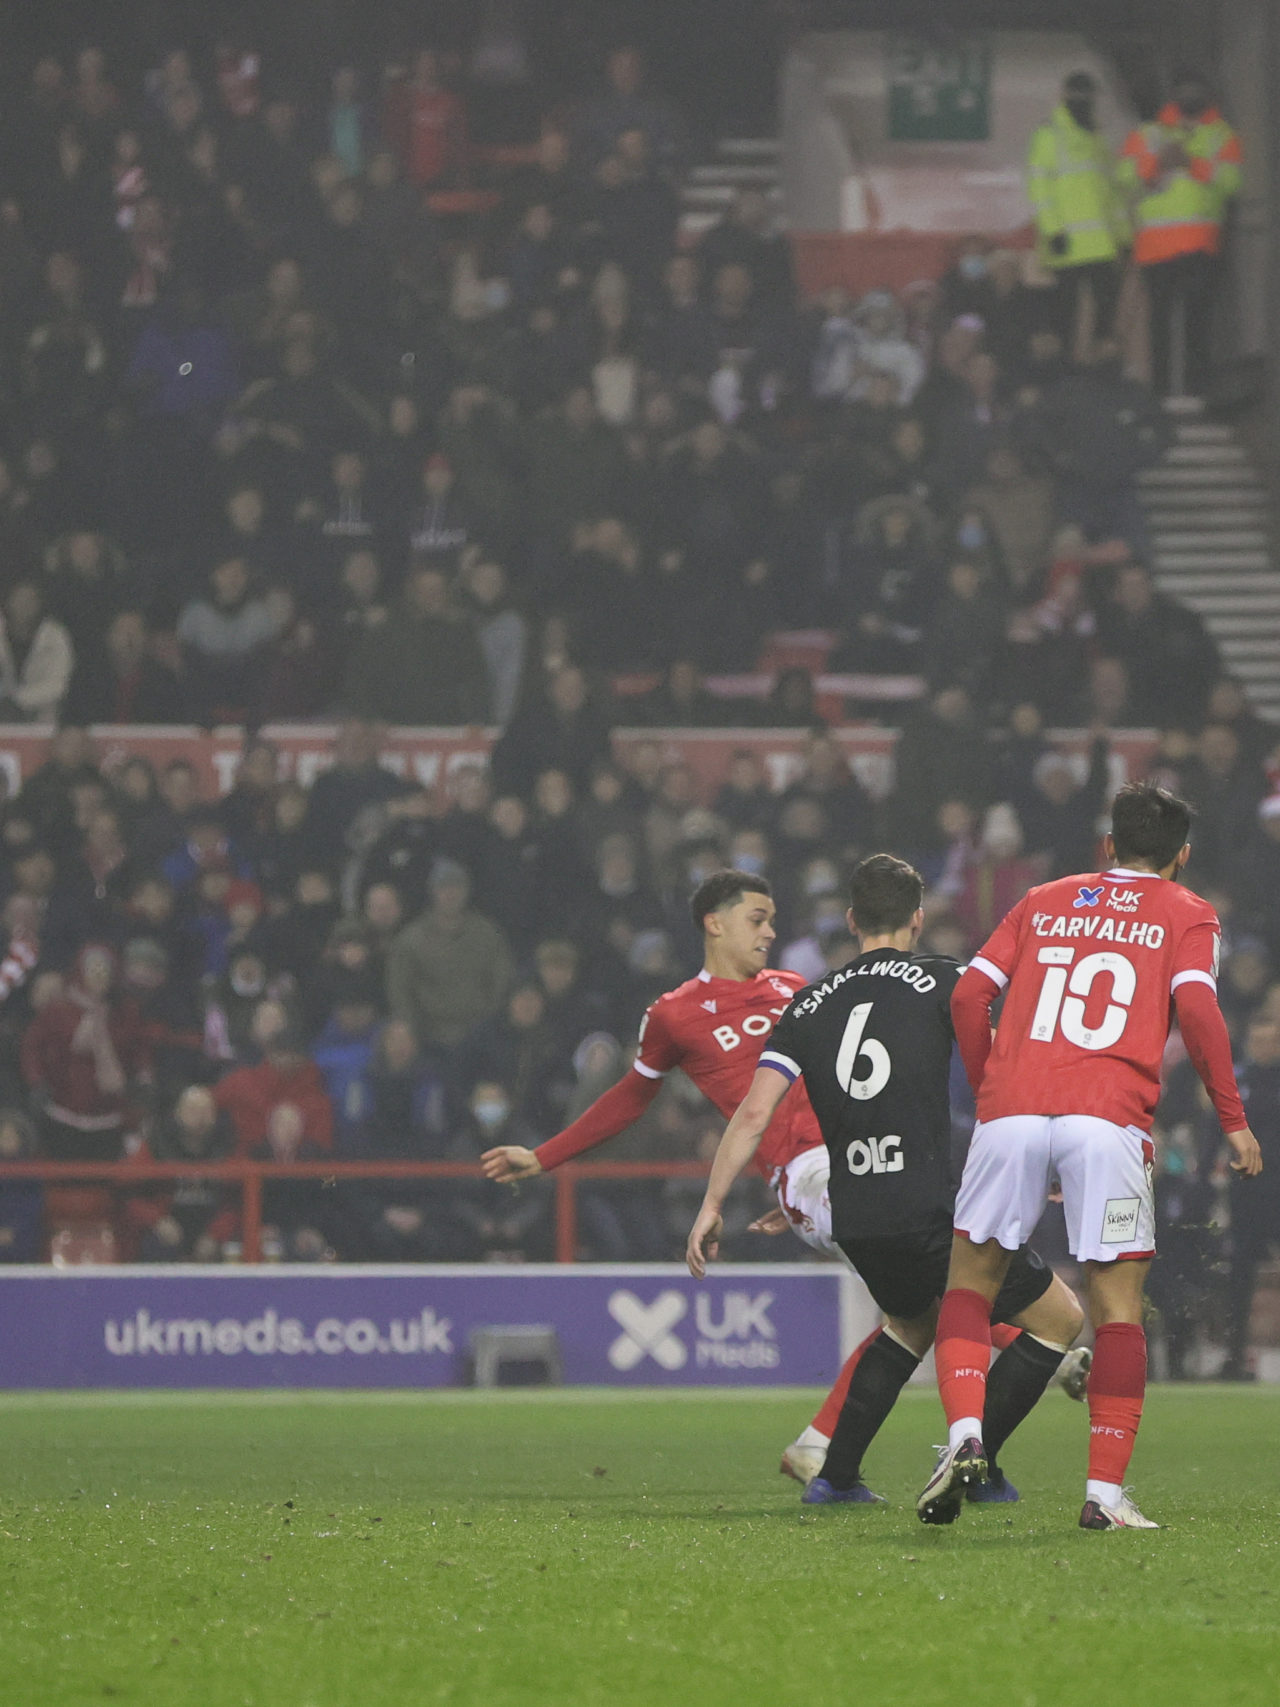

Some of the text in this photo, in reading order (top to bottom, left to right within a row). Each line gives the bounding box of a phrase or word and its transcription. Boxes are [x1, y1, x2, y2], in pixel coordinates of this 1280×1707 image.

[1105, 898, 1138, 912] Meds
[1110, 887, 1144, 905] UK
[1035, 915, 1165, 949] CARVALHO
[802, 960, 937, 1015] SMALLWOOD
[1029, 946, 1137, 1051] 10
[835, 1001, 892, 1101] 6
[846, 1134, 905, 1176] OLG
[1107, 1209, 1136, 1225] SKINNY
[104, 1307, 453, 1355] ukmeds.co.uk
[695, 1290, 777, 1340] UK
